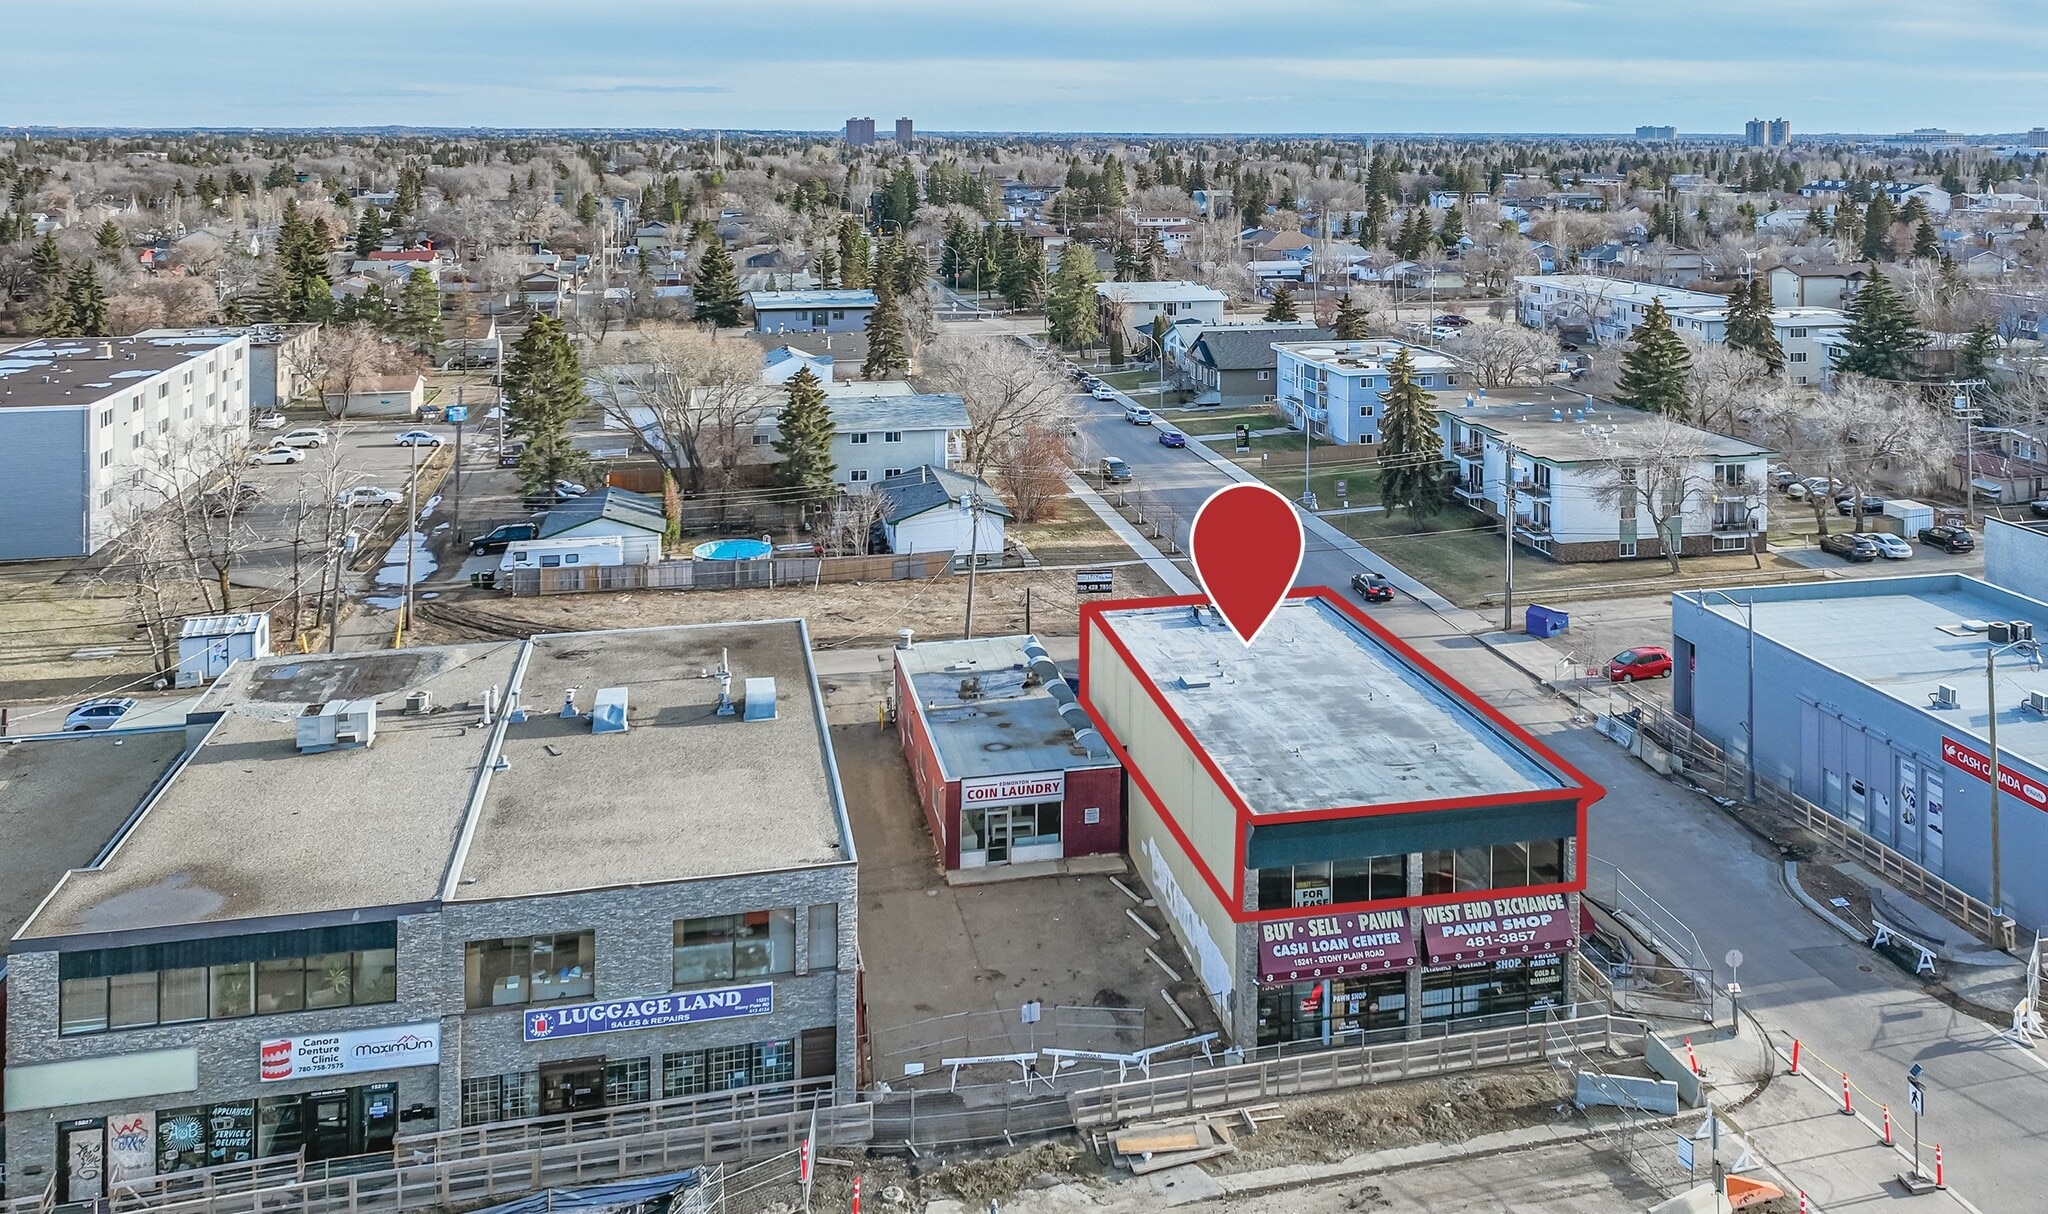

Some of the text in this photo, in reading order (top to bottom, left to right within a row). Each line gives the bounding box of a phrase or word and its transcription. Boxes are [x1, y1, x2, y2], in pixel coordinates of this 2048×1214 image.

[1957, 751, 1981, 771] CASH
[999, 779, 1030, 787] EDMONTON
[967, 781, 1061, 800] COIN LAUNDRY
[1302, 889, 1323, 899] FOR
[1422, 893, 1565, 925] WEST END EXCHANGE
[1262, 910, 1404, 943] BUY SELL PAWN
[1441, 914, 1553, 938] PAWN SHOP
[1311, 937, 1349, 953] LOAN
[1352, 932, 1401, 948] CENTER
[1465, 930, 1536, 948] 481-3857
[1293, 949, 1385, 967] 15241 STONY PLAIN ROAD
[1529, 957, 1560, 968] PAID FOR
[1495, 958, 1522, 970] SHOP
[1534, 968, 1556, 978] GOLD &
[1529, 975, 1560, 986] DIAMONDS
[1332, 991, 1367, 1003] PAWN SHOP
[558, 990, 742, 1026] LUGGAGE LAND
[611, 1014, 690, 1029] SALES & REPAIRS
[303, 1037, 340, 1047] Canora
[298, 1045, 340, 1056] Denture
[311, 1054, 339, 1064] Clinic
[298, 1062, 344, 1073] 780-758-7575
[212, 1107, 254, 1117] APPLIANCES
[214, 1130, 246, 1139] SERVICE
[214, 1138, 251, 1148] DELIVERY
